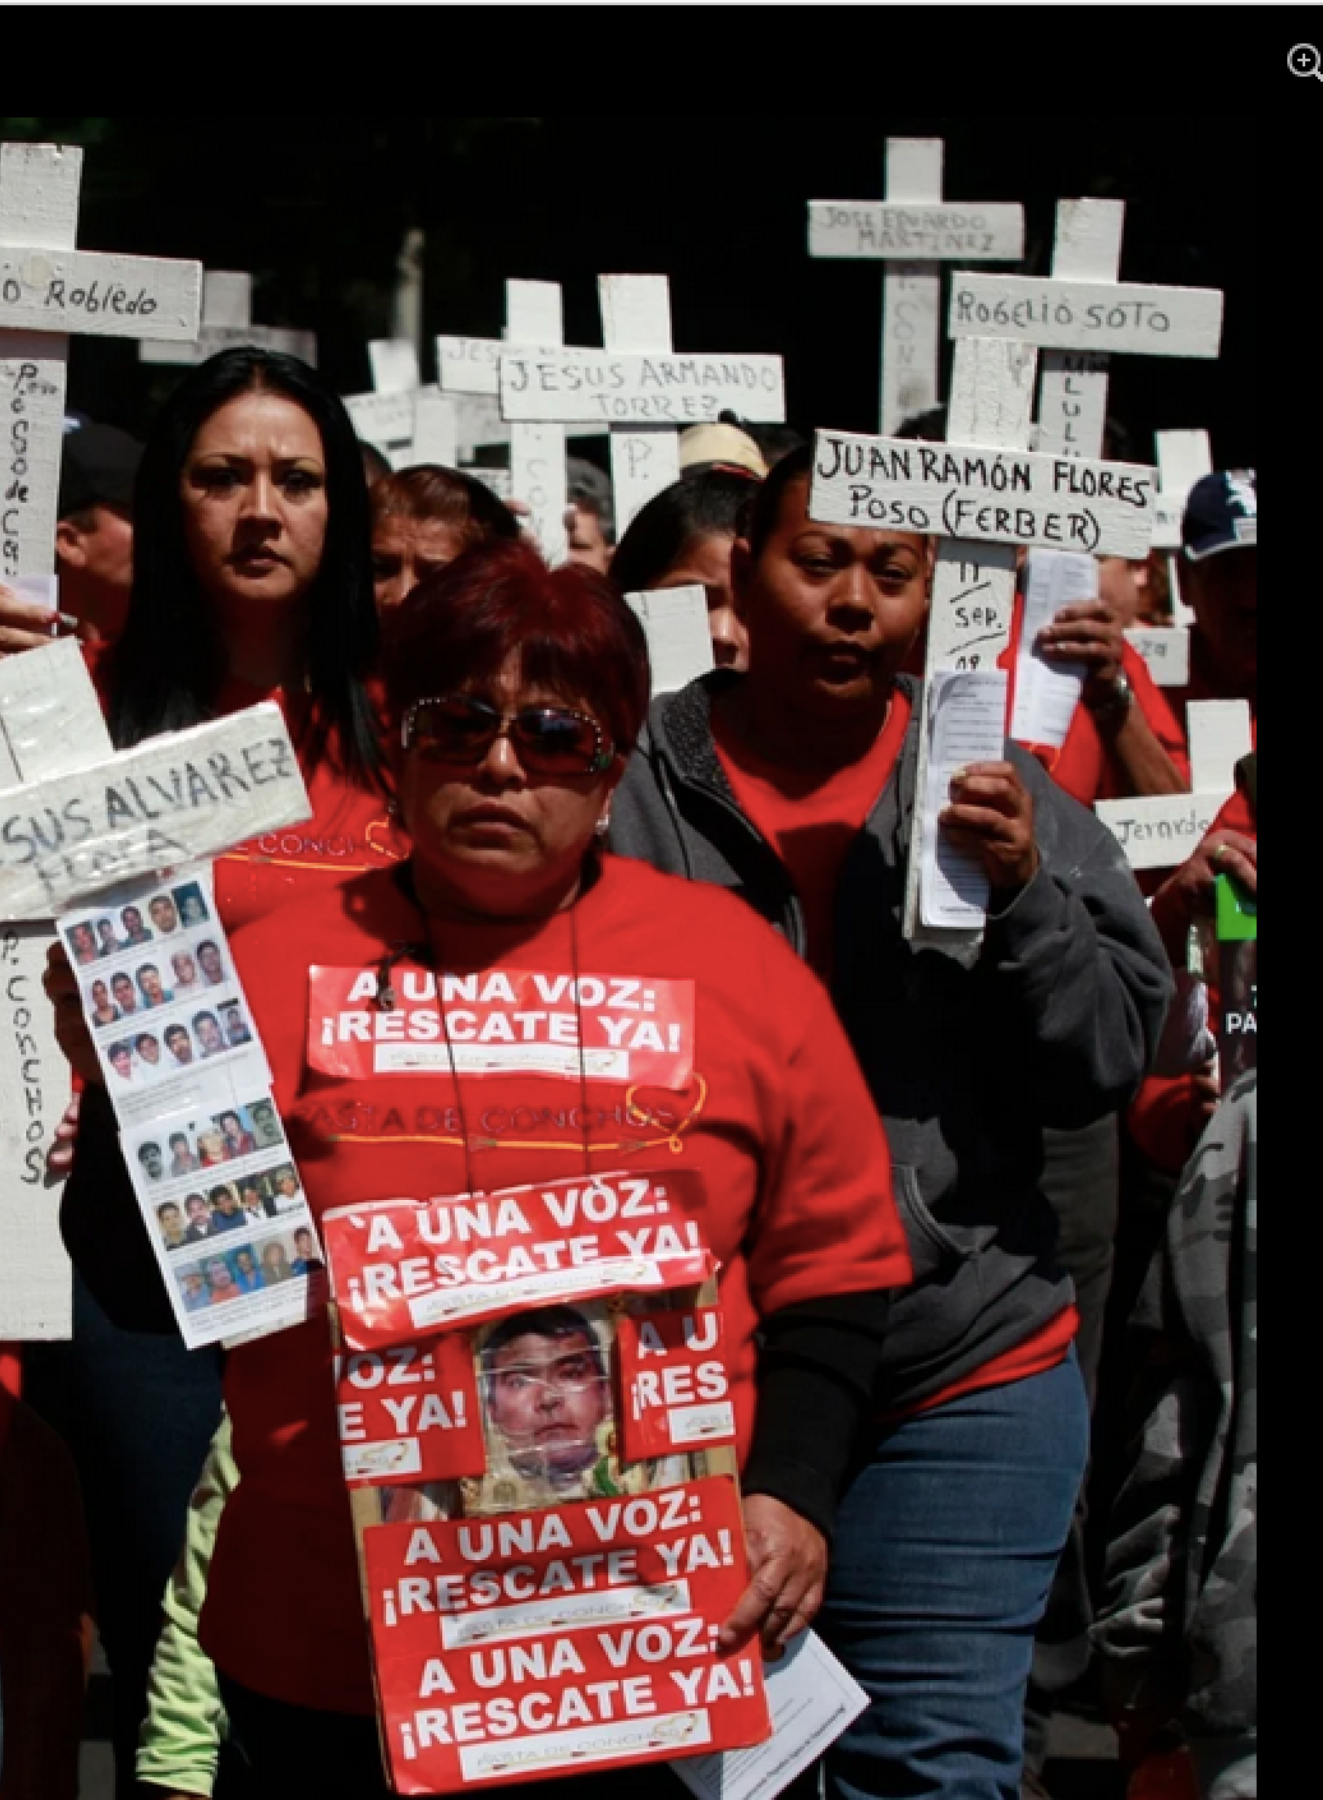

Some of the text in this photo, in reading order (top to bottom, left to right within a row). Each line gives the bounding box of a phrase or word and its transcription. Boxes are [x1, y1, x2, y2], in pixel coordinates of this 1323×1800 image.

[509, 358, 777, 392] JESUS ARMANDO
[817, 438, 1150, 507] JUAN RAMÓN FLORES
[347, 971, 656, 1011] A UNA VOZ:
[321, 1010, 681, 1053] ¡RESCATE YA!
[367, 1178, 671, 1254] A UNA VOZ:
[347, 1236, 599, 1312] ¡RESCATE
[617, 1221, 700, 1260] YA!
[335, 1347, 436, 1390] OZ:
[636, 1321, 668, 1360] A
[383, 1391, 467, 1434] YA!
[404, 1490, 702, 1566] A UNA VOZ:
[383, 1528, 735, 1627] ¡RESCATE YA!
[419, 1618, 721, 1698] A UNA VOZ:
[400, 1674, 657, 1760] ¡RESCATE
[670, 1659, 755, 1708] YA!
